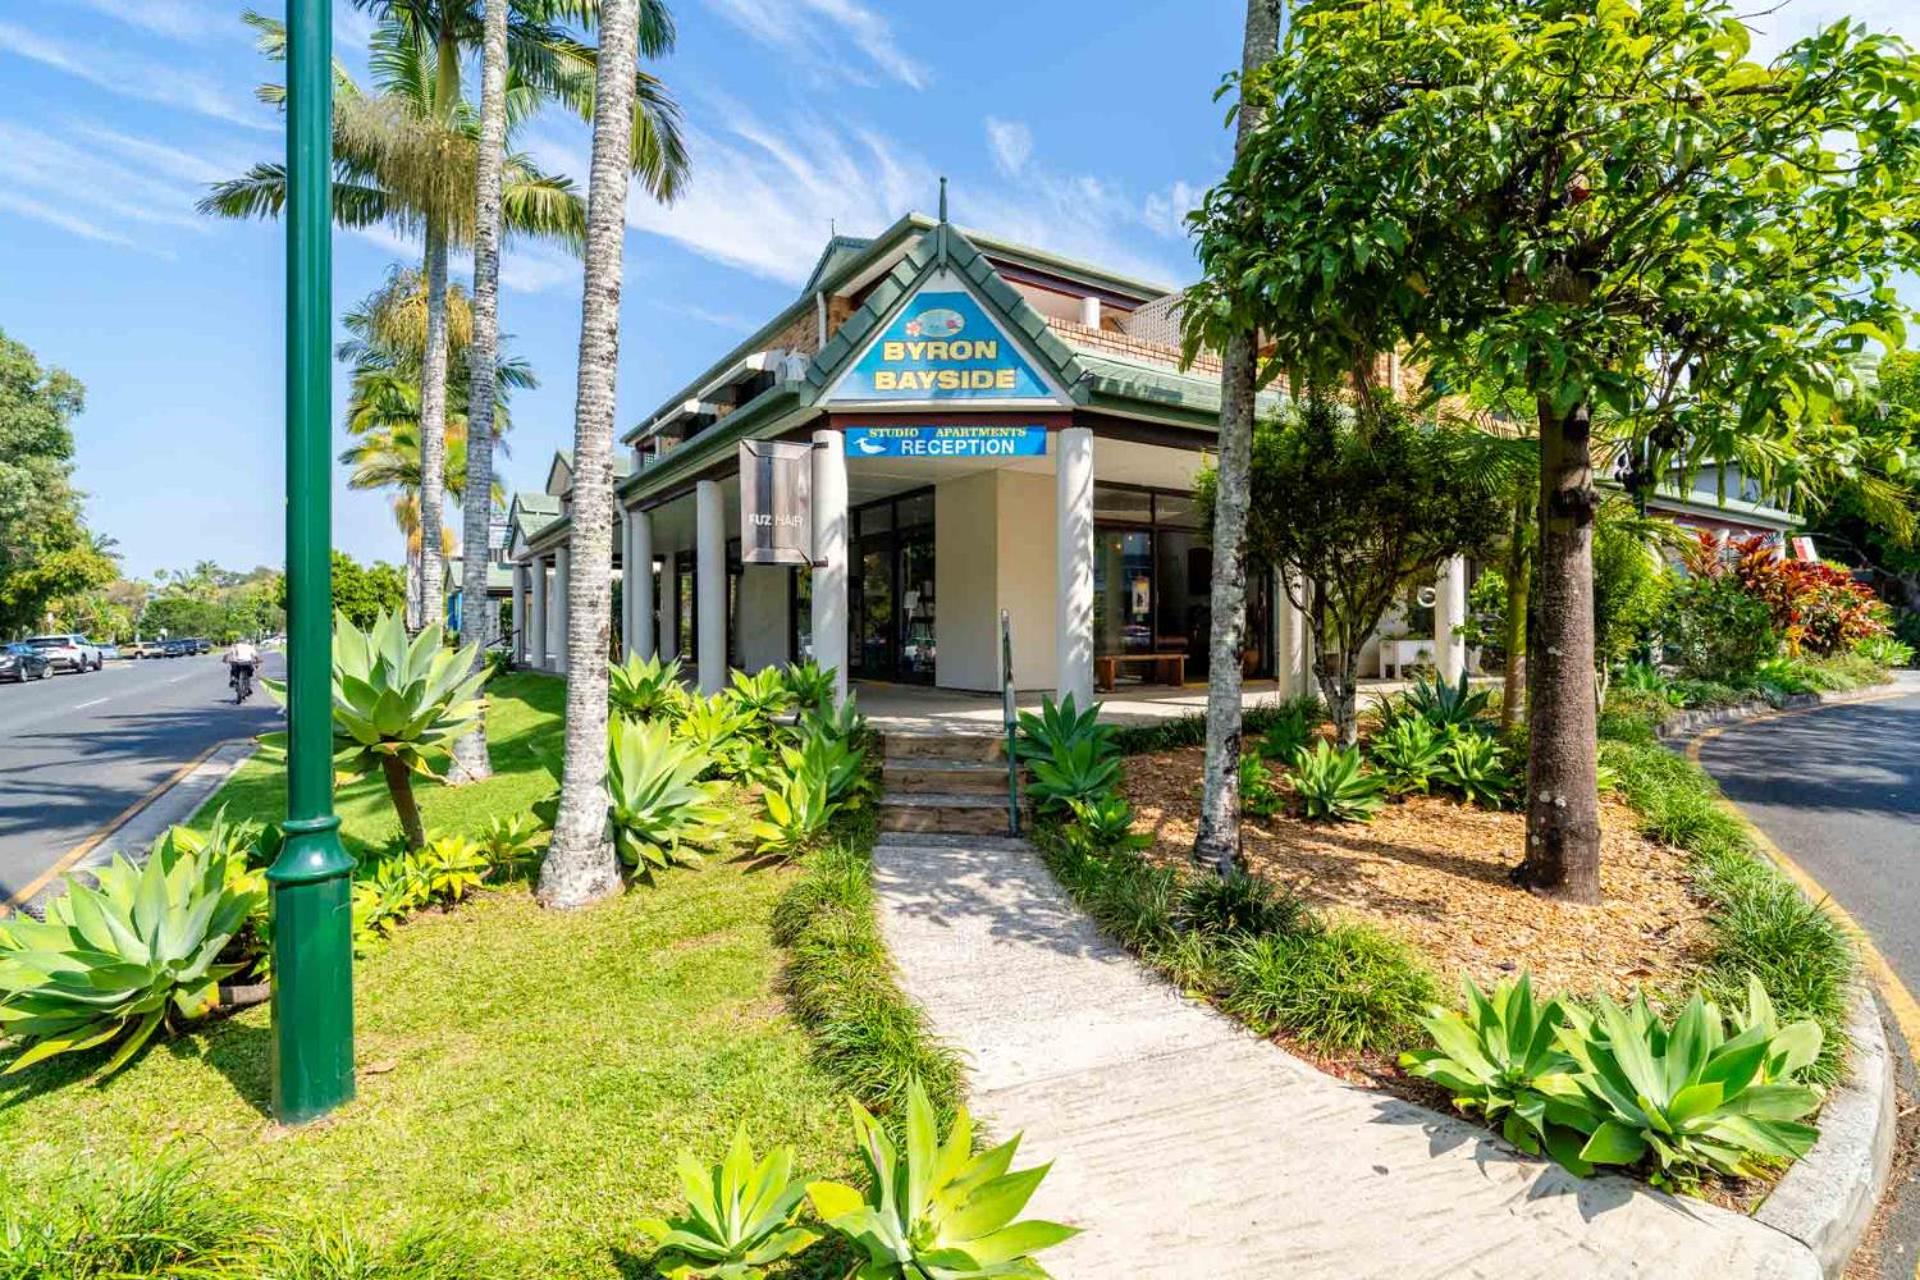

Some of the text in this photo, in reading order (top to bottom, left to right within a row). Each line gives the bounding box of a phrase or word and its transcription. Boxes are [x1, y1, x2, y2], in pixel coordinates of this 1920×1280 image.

[883, 341, 997, 361] BYRON
[874, 369, 1016, 390] BAYSIDE
[869, 427, 1026, 438] STUDIO APARTMENTS
[901, 439, 1015, 455] RECEPTION
[749, 513, 803, 527] FUZ HAIR
